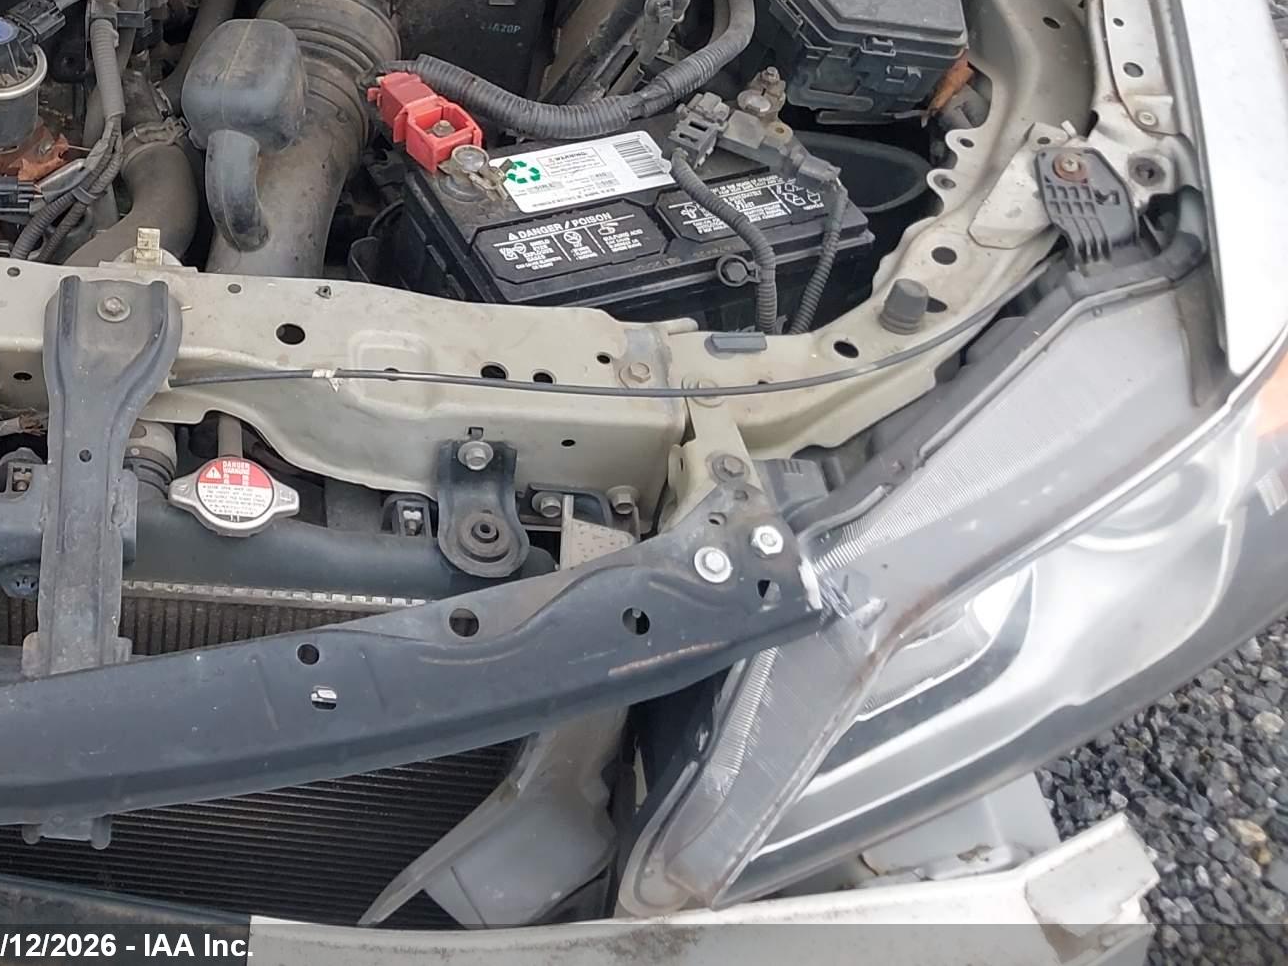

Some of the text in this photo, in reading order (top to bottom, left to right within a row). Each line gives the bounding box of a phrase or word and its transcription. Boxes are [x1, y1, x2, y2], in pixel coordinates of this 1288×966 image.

[518, 223, 563, 239] DANGER
[571, 212, 612, 228] POISON
[222, 461, 250, 470] DANGER
